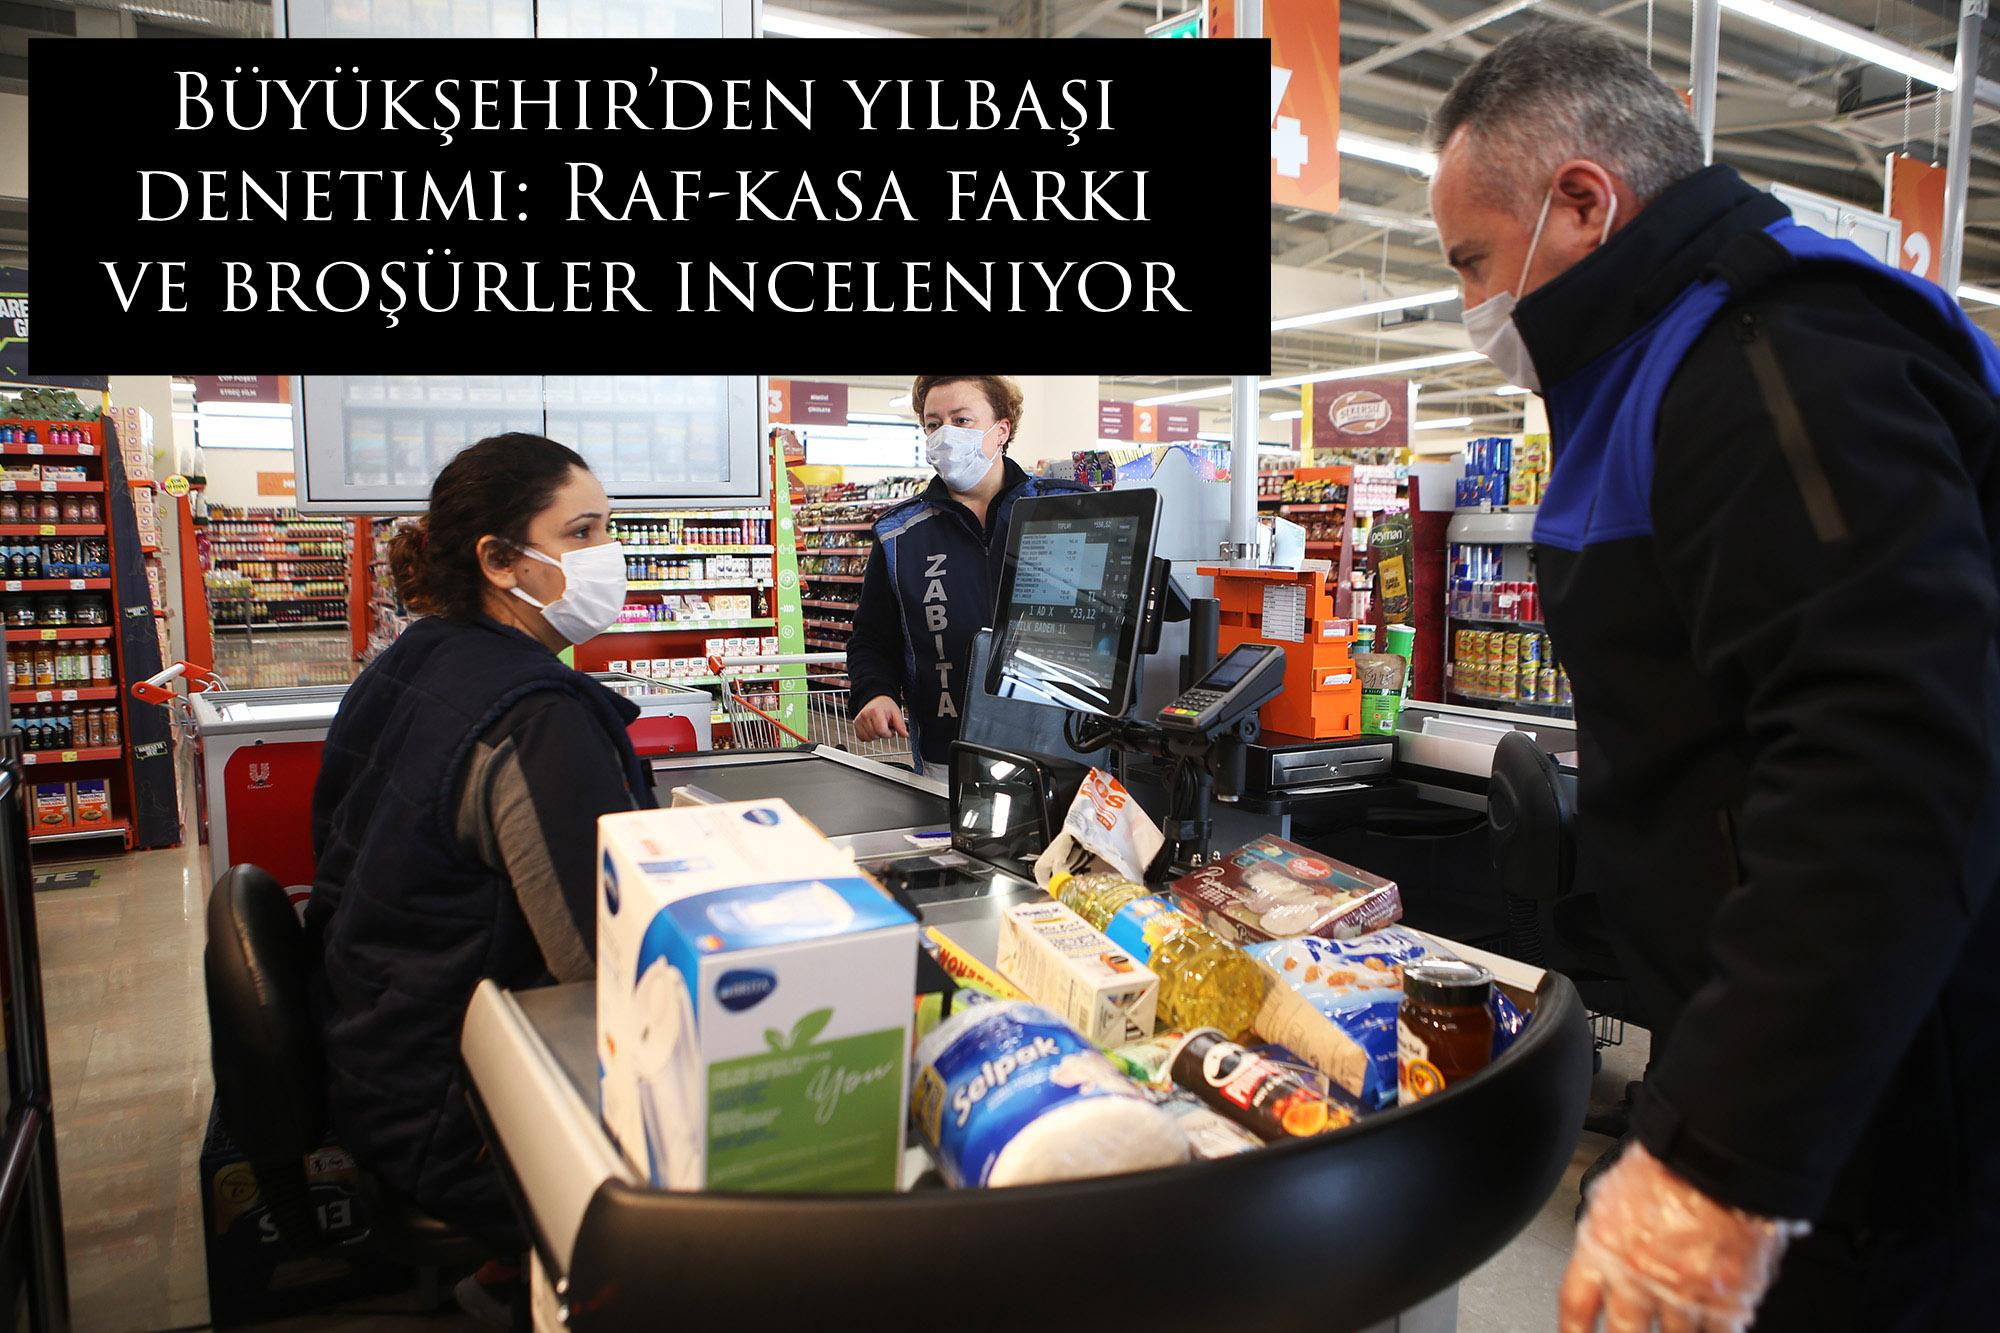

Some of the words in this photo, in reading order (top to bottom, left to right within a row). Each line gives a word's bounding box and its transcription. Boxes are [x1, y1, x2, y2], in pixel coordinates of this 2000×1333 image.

[1139, 411, 1152, 433] 2
[1371, 529, 1402, 544] peyman
[922, 553, 958, 718] ZABITA
